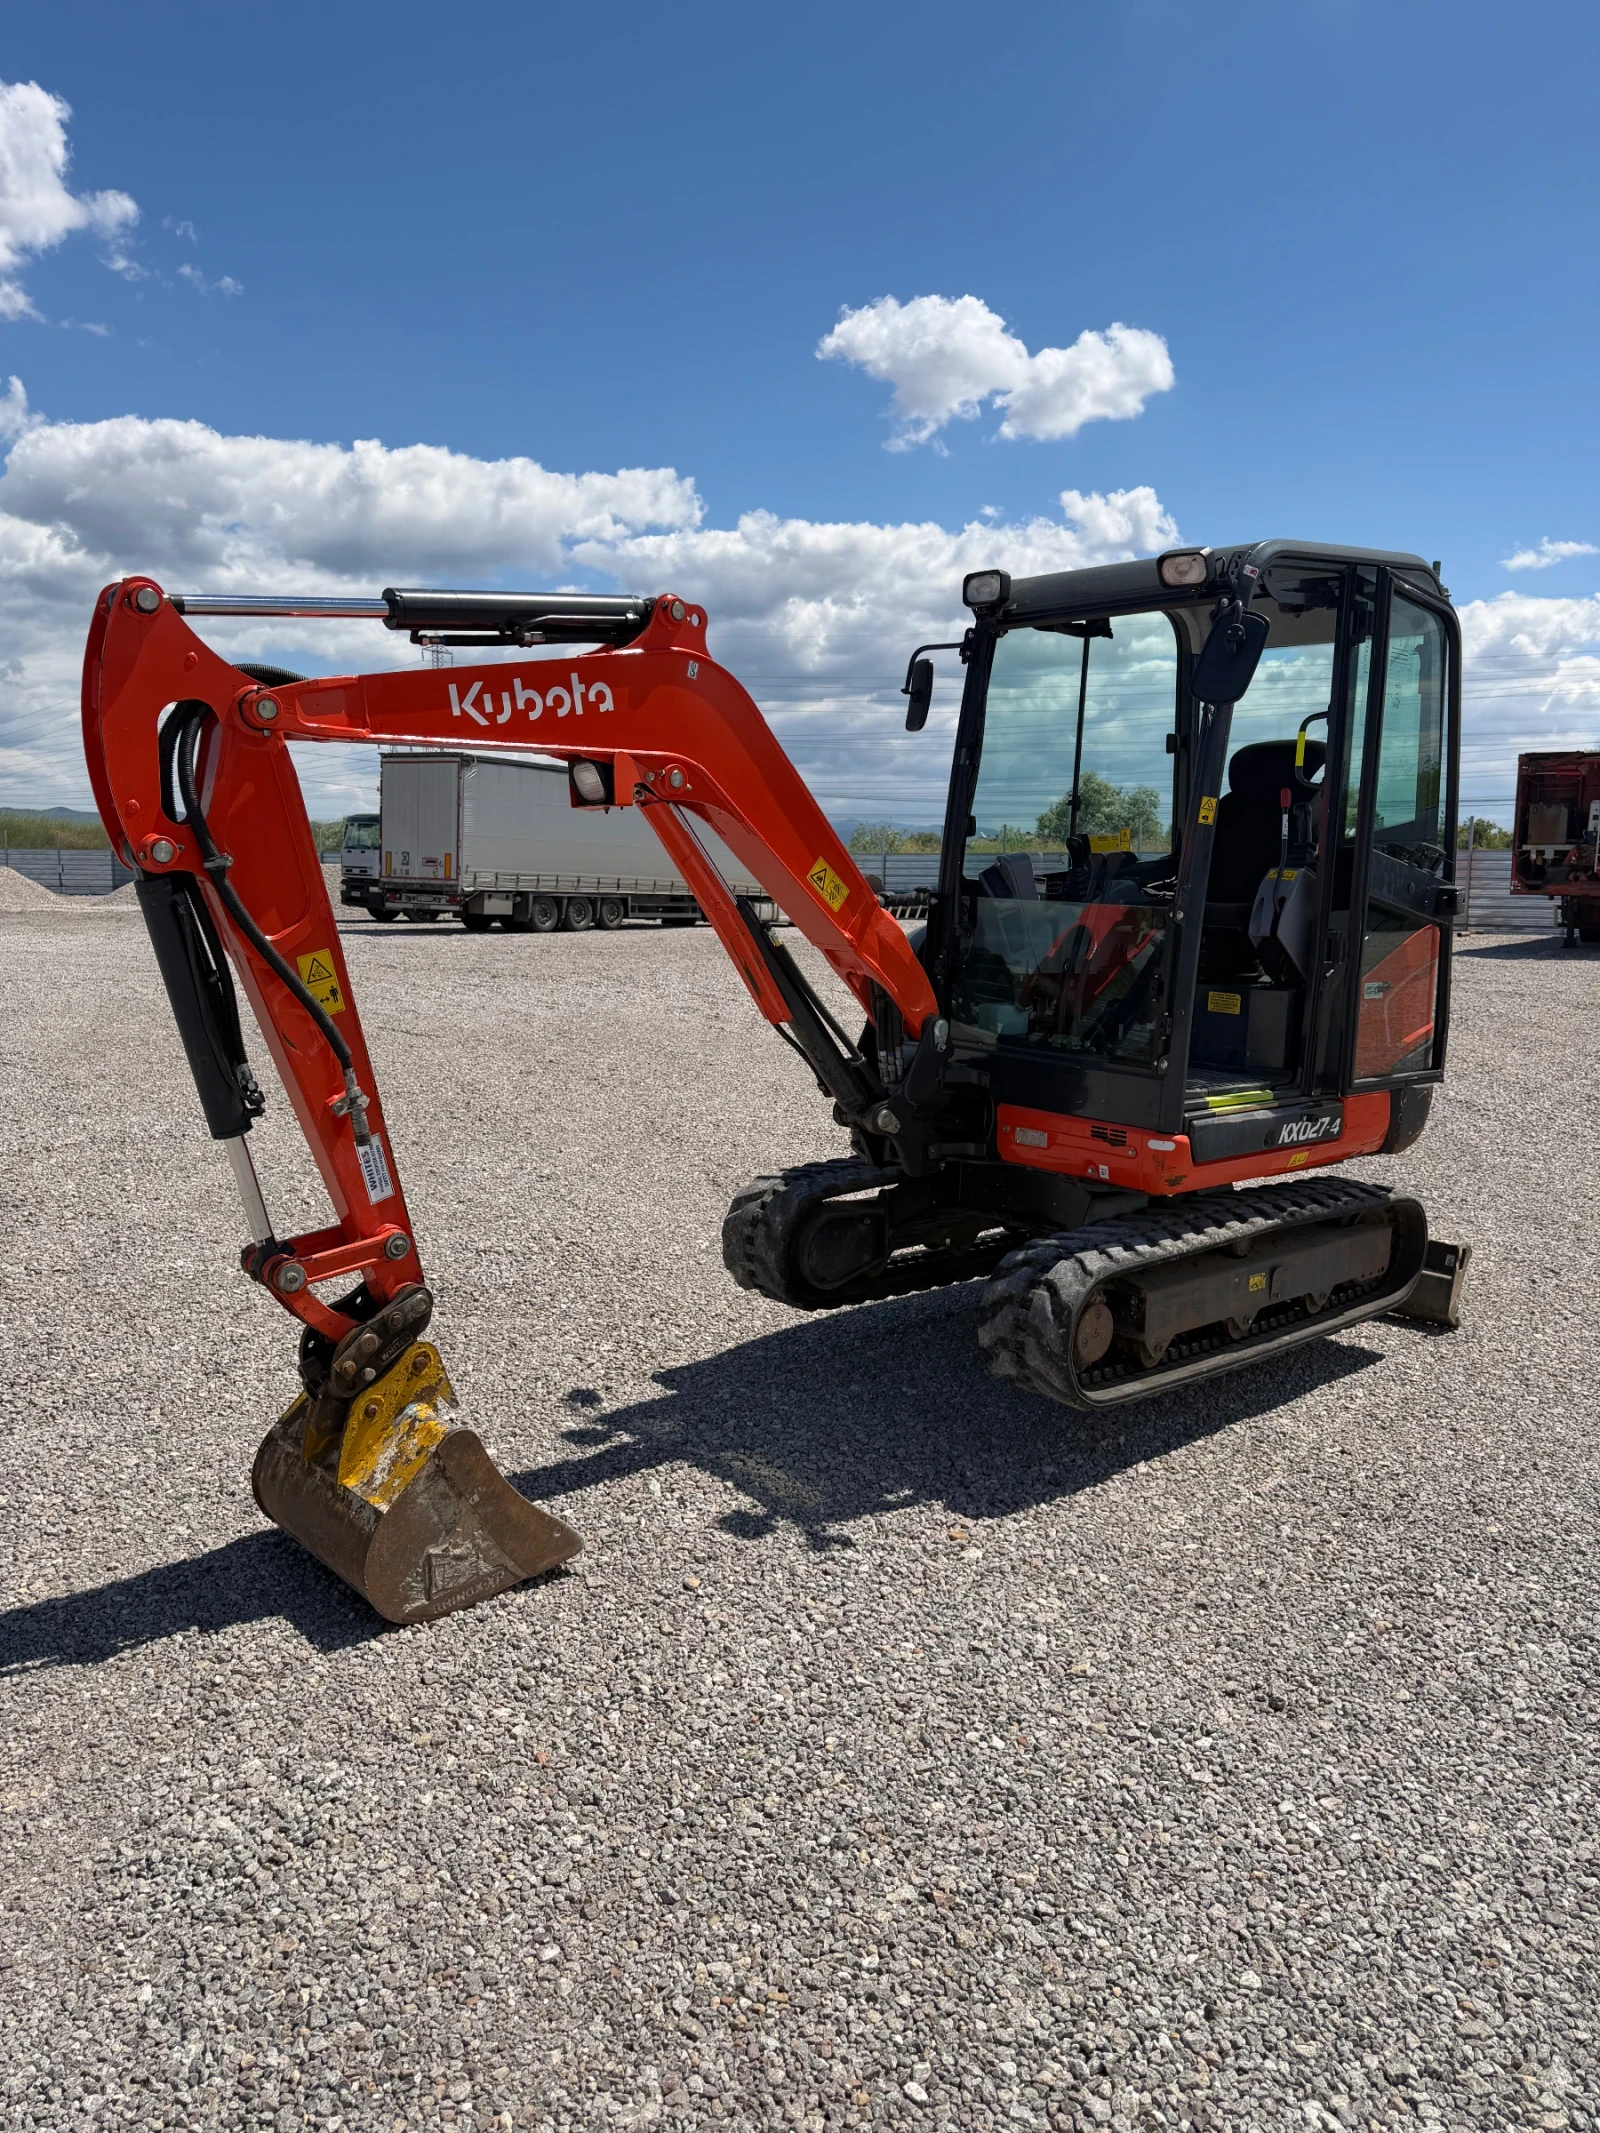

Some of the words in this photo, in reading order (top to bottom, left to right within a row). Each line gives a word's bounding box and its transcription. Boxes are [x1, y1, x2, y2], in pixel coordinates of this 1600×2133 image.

[448, 672, 615, 726] Kubota
[1278, 1116, 1341, 1145] KX027-4
[361, 1150, 377, 1191] WHITES
